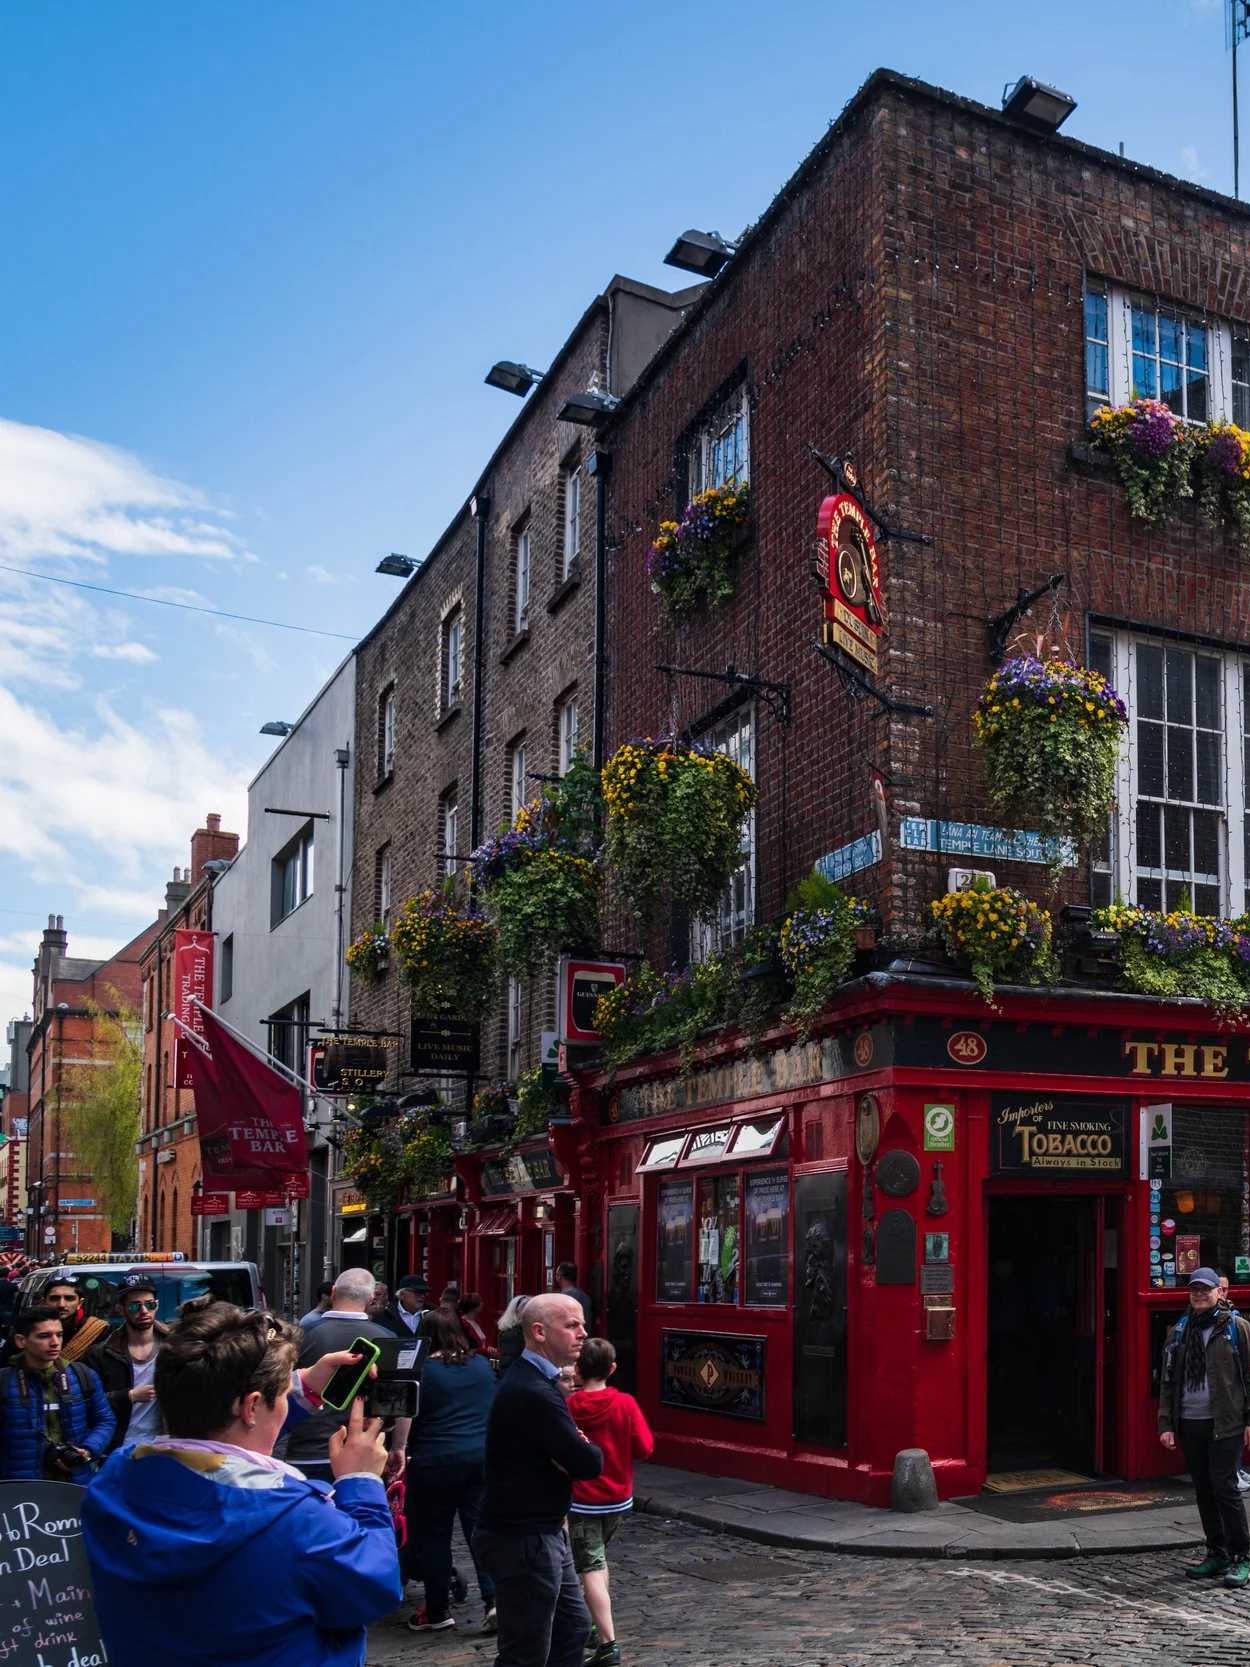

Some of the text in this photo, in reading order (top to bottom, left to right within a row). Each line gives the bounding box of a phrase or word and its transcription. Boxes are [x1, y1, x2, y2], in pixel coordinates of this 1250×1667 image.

[838, 500, 870, 543] TEMPLE
[869, 545, 879, 589] BAR
[984, 844, 1010, 858] LANE
[194, 957, 206, 982] THE
[181, 974, 191, 1023] TRADING
[322, 1037, 400, 1049] THE TEMPLE BAR
[418, 1043, 475, 1054] LIVE MUSIC
[857, 1038, 871, 1061] 48
[953, 1036, 979, 1057] 48
[430, 1053, 460, 1061] DAILY
[1124, 1040, 1228, 1078] THE
[640, 1045, 822, 1116] THE TEMPLE BAR
[997, 1101, 1054, 1126] Importers
[1032, 1115, 1043, 1123] OF
[228, 1127, 299, 1144] TEMPE
[1047, 1120, 1112, 1132] FINE SMOKING
[250, 1140, 287, 1154] BAR
[1012, 1125, 1113, 1164] TOBACCO
[1033, 1157, 1121, 1168] Always in Stock
[76, 1254, 107, 1263] 52244
[12, 1502, 83, 1539] Rom
[12, 1537, 70, 1572] Deal
[27, 1577, 92, 1610] Main
[12, 1611, 85, 1637] of wine
[34, 1631, 78, 1649] drink
[67, 1639, 108, 1667] deal
